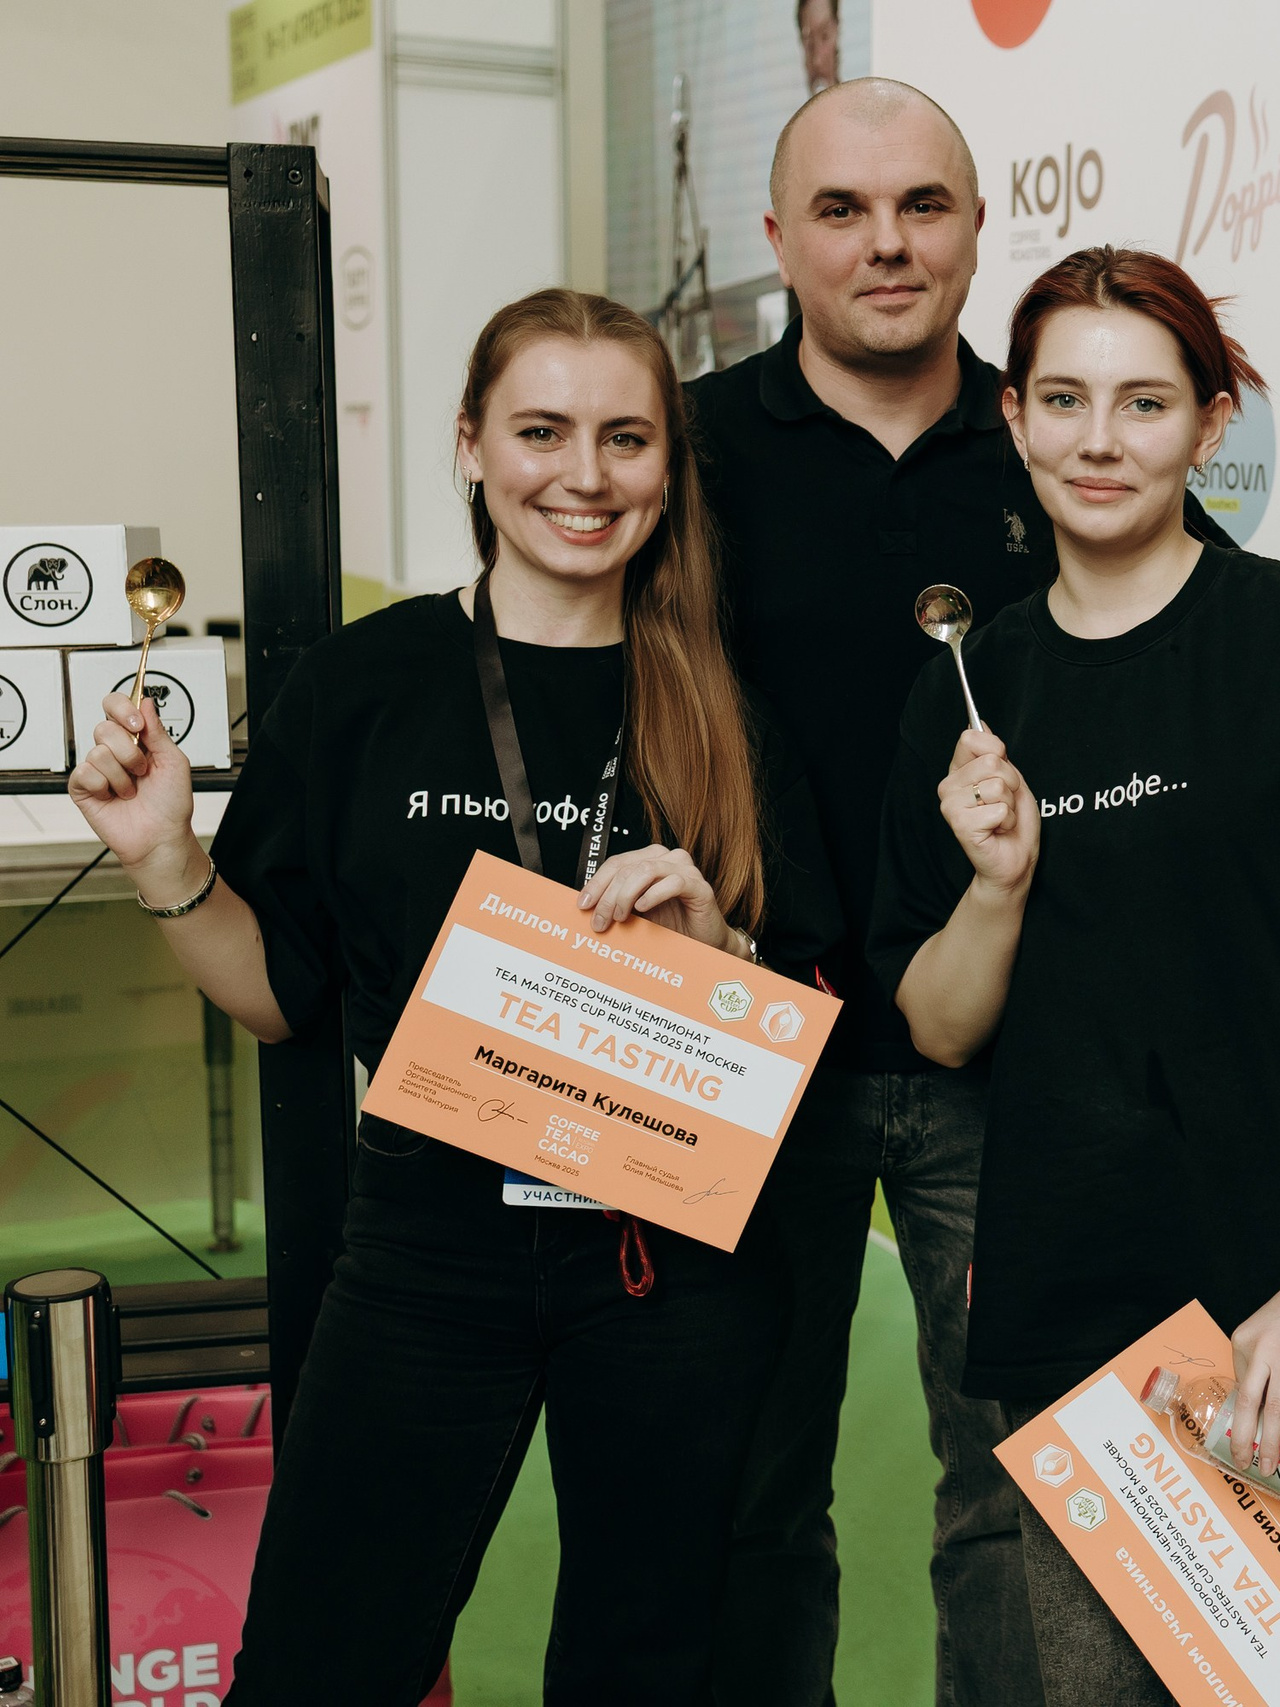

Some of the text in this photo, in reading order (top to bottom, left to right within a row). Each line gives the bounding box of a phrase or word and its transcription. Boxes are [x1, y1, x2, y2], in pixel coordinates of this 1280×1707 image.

[1010, 142, 1103, 239] KOJO
[19, 595, 79, 611] Слон.
[407, 790, 429, 819] Я
[441, 794, 510, 821] пью
[592, 791, 608, 831] CACAO
[1040, 772, 1188, 819] ью кофе...
[588, 833, 601, 857] TEA
[478, 893, 683, 987] Диплом участника
[495, 966, 516, 984] TEA
[520, 978, 578, 1008] MASTERS
[580, 1002, 605, 1017] CUP
[607, 1013, 649, 1037] RUSSIA
[652, 1031, 682, 1050] 2025
[695, 1048, 747, 1076] МОСКВЕ
[544, 972, 711, 1045] ОТБОРОЧНЫЙ ЧЕМПИОНАТ
[499, 991, 723, 1101] TEA TASTING
[401, 1078, 436, 1095] комитета
[405, 1069, 477, 1101] Организационного
[408, 1060, 461, 1086] Председатель
[397, 1084, 458, 1113] Рамаз Чантурия
[474, 1045, 697, 1146] Маргарита Кулешова
[545, 1125, 570, 1144] TEA
[547, 1113, 601, 1141] COFFEE
[534, 1154, 579, 1176] Москва 2025
[538, 1138, 588, 1164] CACAO
[622, 1163, 684, 1192] Юлия Малышева
[625, 1155, 679, 1181] Главный судья
[1102, 1439, 1140, 1485] МОСКВЕ
[1129, 1432, 1234, 1568] TASTING
[1144, 1494, 1168, 1521] 2025
[1166, 1520, 1197, 1560] RUSSIA
[1119, 1485, 1229, 1628] ОТБОРОЧНЫЙ ЧЕМПИОНАТ
[1194, 1562, 1213, 1583] CUP
[1211, 1584, 1251, 1635] MASTERS
[1115, 1546, 1243, 1707] иплом участника
[1250, 1634, 1267, 1658] TEA
